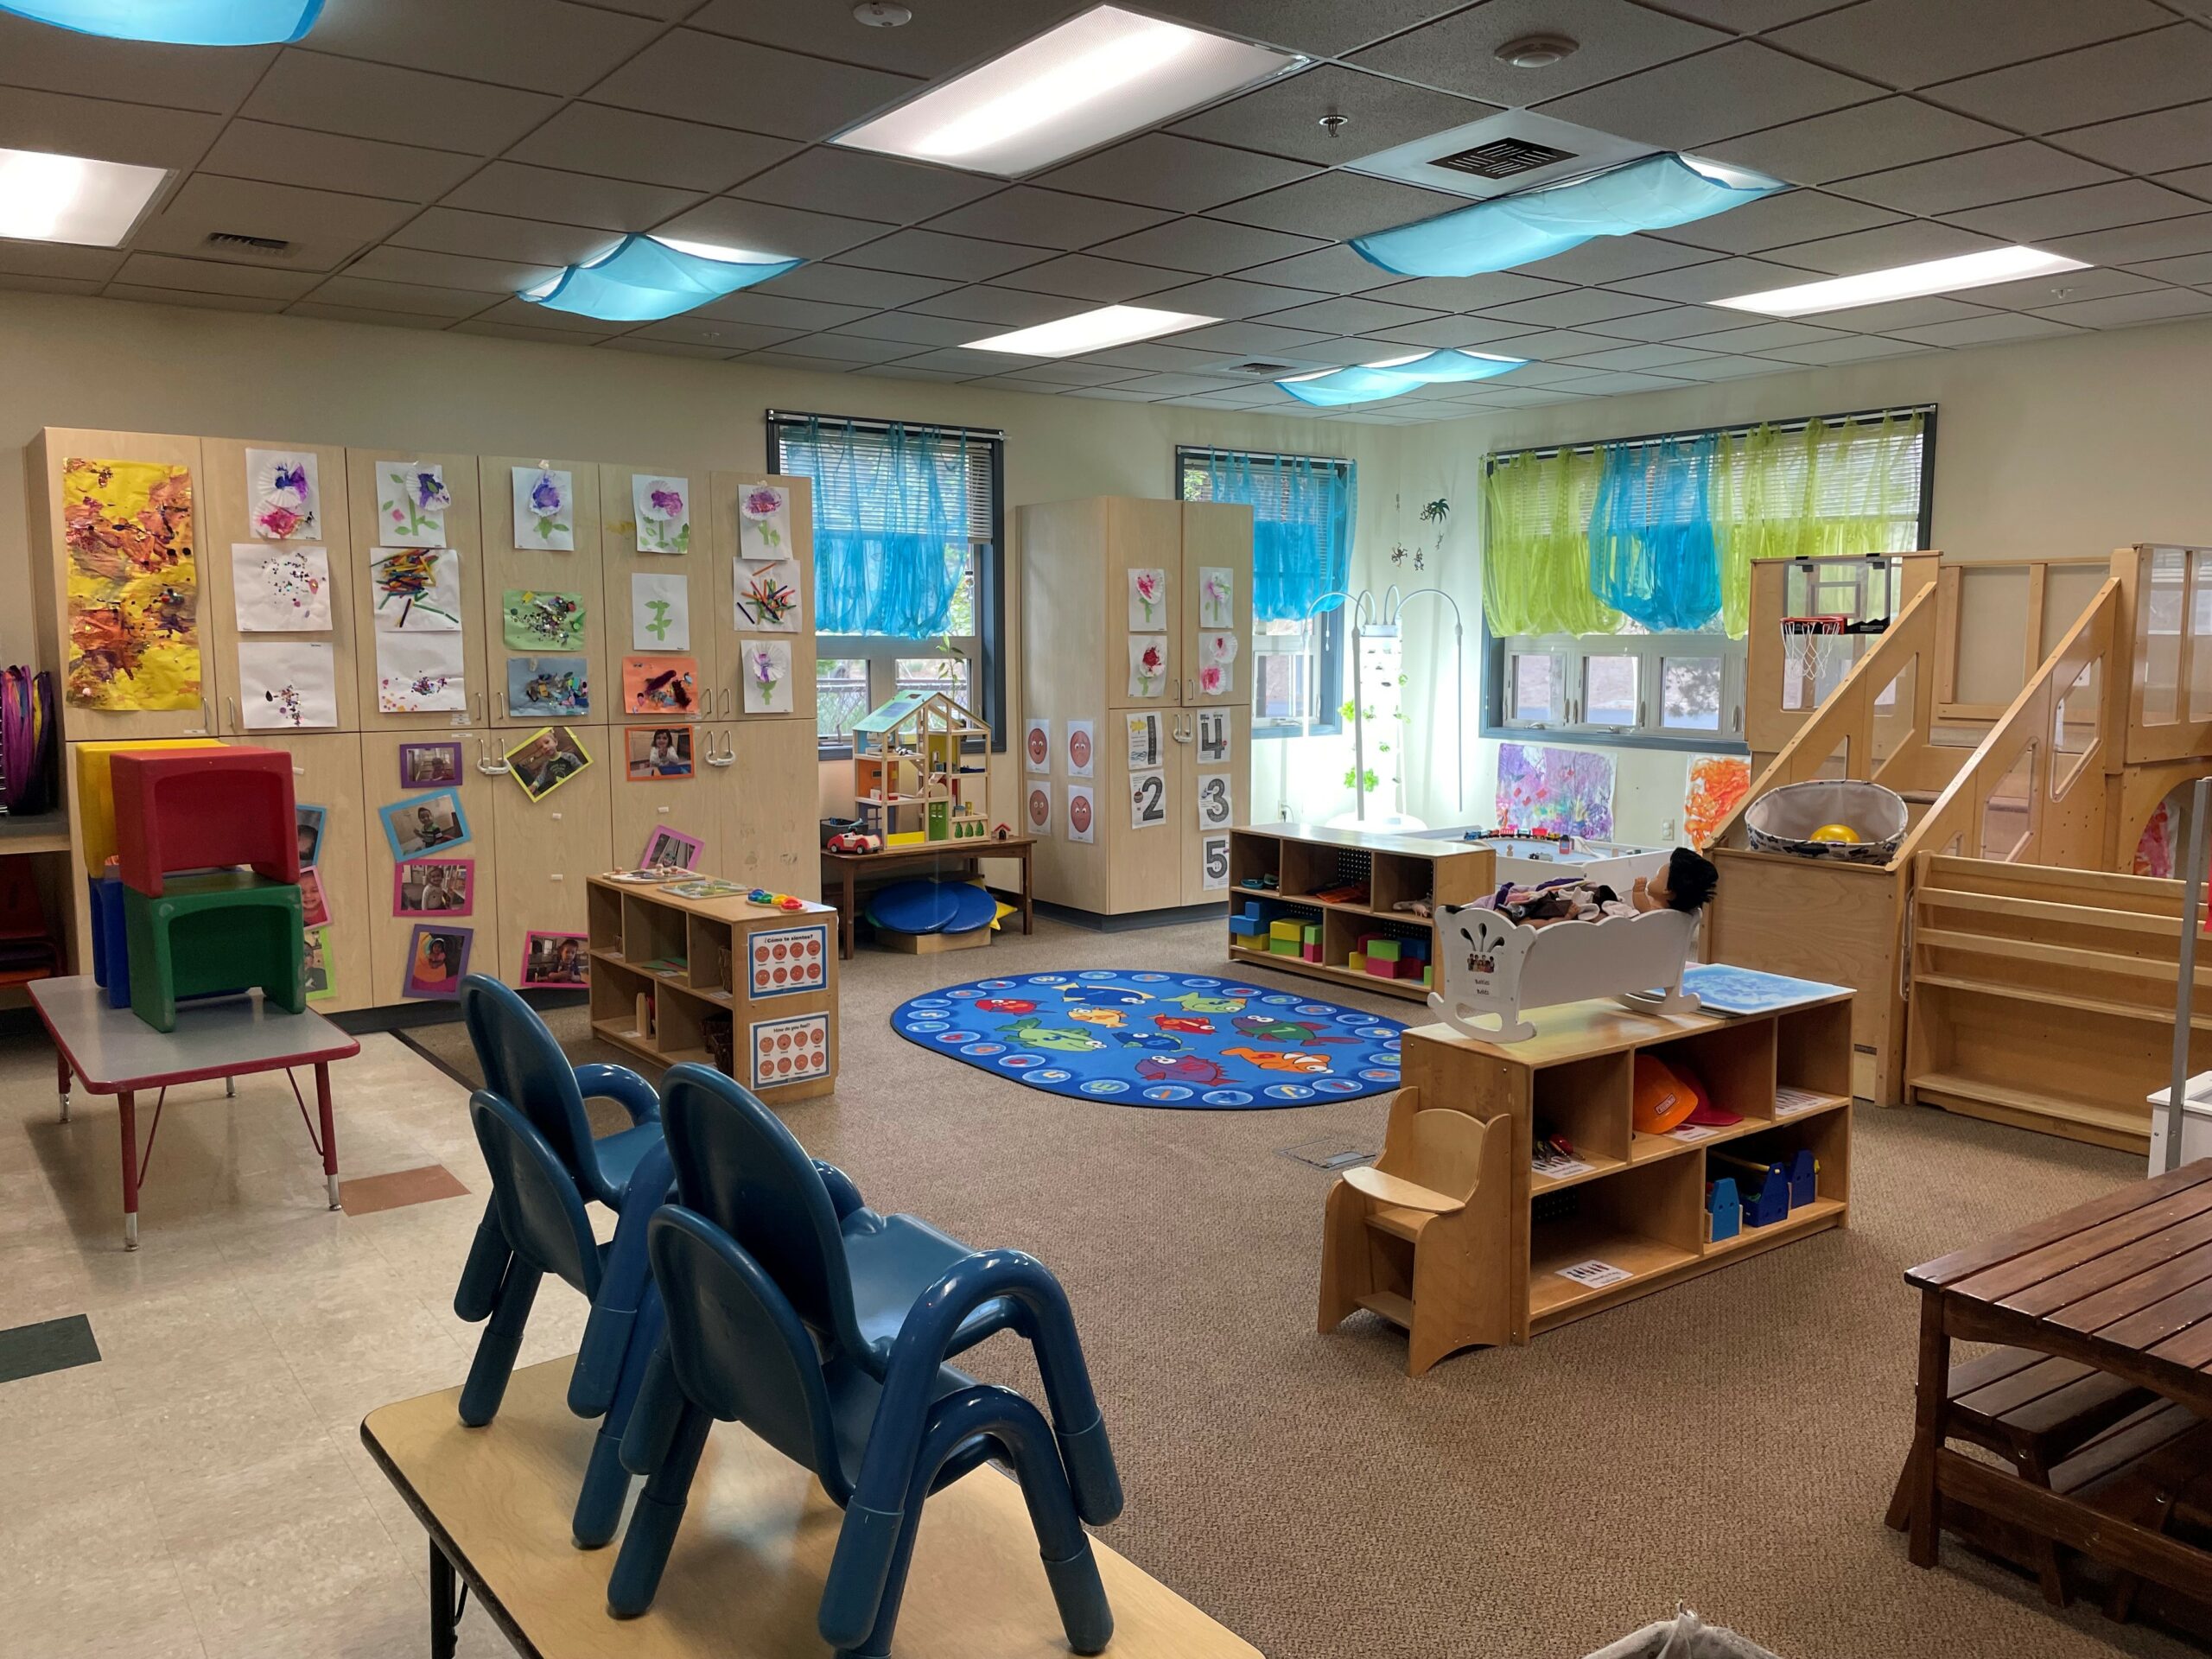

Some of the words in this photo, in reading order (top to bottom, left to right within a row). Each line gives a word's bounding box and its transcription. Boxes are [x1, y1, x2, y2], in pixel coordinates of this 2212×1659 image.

[1147, 715, 1157, 765] 1
[1201, 719, 1225, 760] 4
[1142, 776, 1164, 821] 2
[1206, 778, 1230, 823] 3
[1206, 840, 1228, 879] 5
